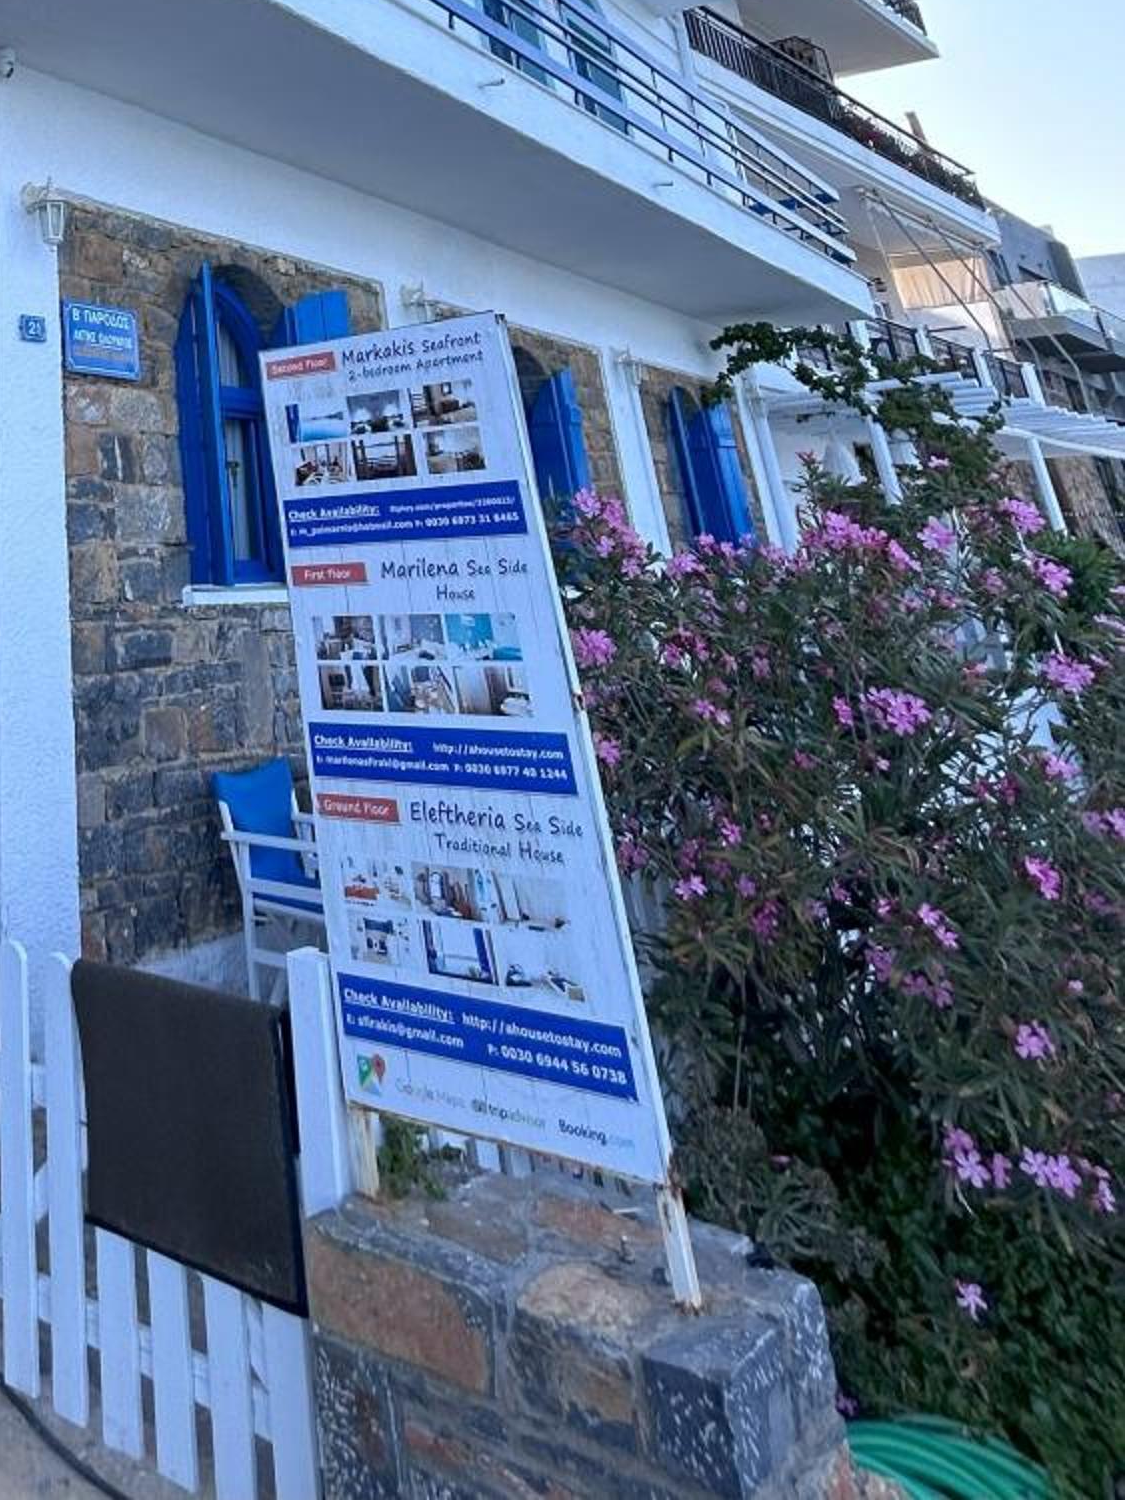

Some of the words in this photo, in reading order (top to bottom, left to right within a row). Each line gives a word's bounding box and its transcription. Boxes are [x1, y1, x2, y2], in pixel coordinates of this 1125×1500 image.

[342, 338, 415, 366] Markakis
[422, 331, 482, 352] Seafront
[272, 362, 304, 375] Second
[348, 362, 412, 381] 2-bedroom
[417, 349, 484, 370] Apartment
[288, 508, 316, 520] Check
[425, 516, 450, 528] 0030
[304, 568, 324, 580] First
[380, 557, 459, 579] Marilena
[497, 557, 528, 575] Side
[436, 585, 475, 601] House
[314, 735, 345, 748] Check
[348, 736, 413, 752] Availability:
[465, 763, 491, 775] 0030
[324, 797, 361, 812] Ground
[410, 801, 505, 829] Eleftheria
[514, 813, 542, 833] Sea
[548, 816, 584, 837] Side
[434, 833, 511, 857] Traditional
[518, 841, 565, 864] House
[344, 987, 378, 1005] Check
[381, 995, 454, 1023] Availability:
[500, 1045, 534, 1063] 0030
[536, 1052, 569, 1071] 6944
[572, 1060, 590, 1076] 56
[591, 1064, 628, 1085] 0738
